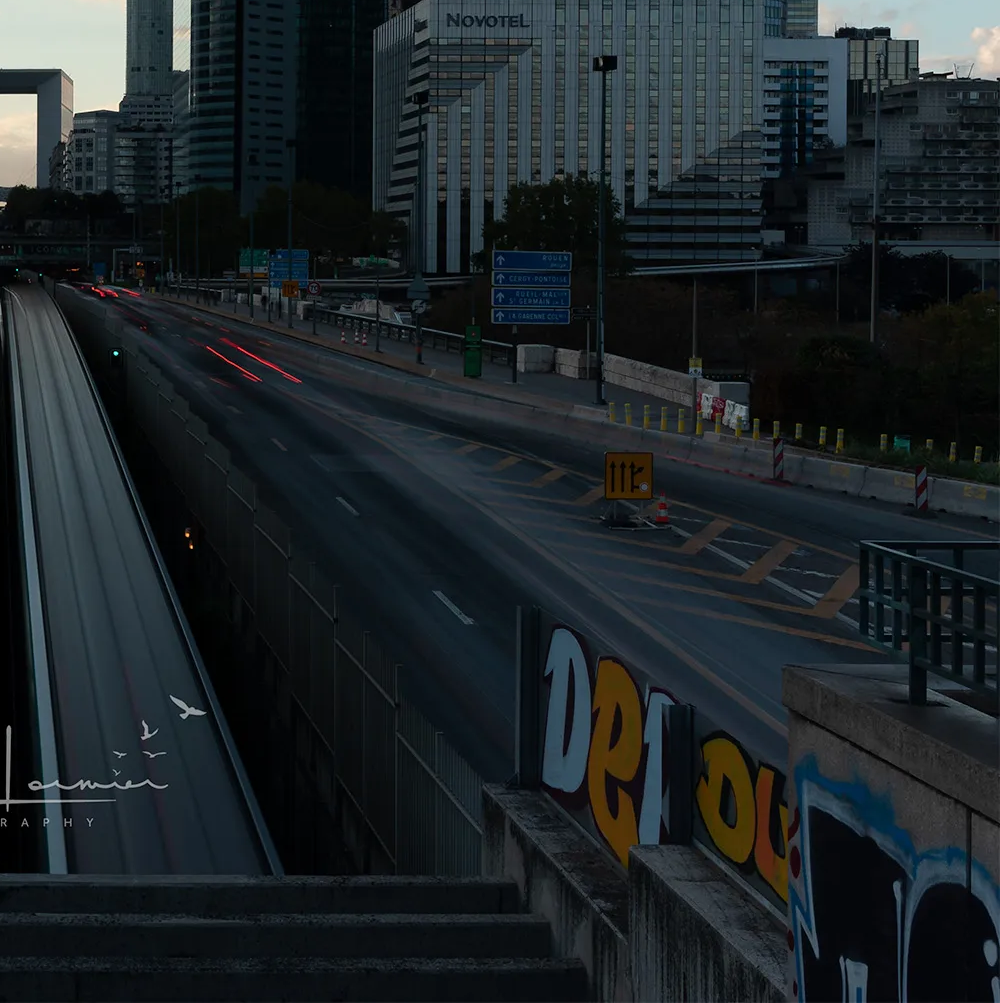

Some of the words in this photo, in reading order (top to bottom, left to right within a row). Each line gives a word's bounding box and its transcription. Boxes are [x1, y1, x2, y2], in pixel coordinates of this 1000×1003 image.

[446, 13, 530, 28] NOVOTEL
[542, 254, 569, 262] ROUEN
[519, 297, 551, 305] GERMAIN
